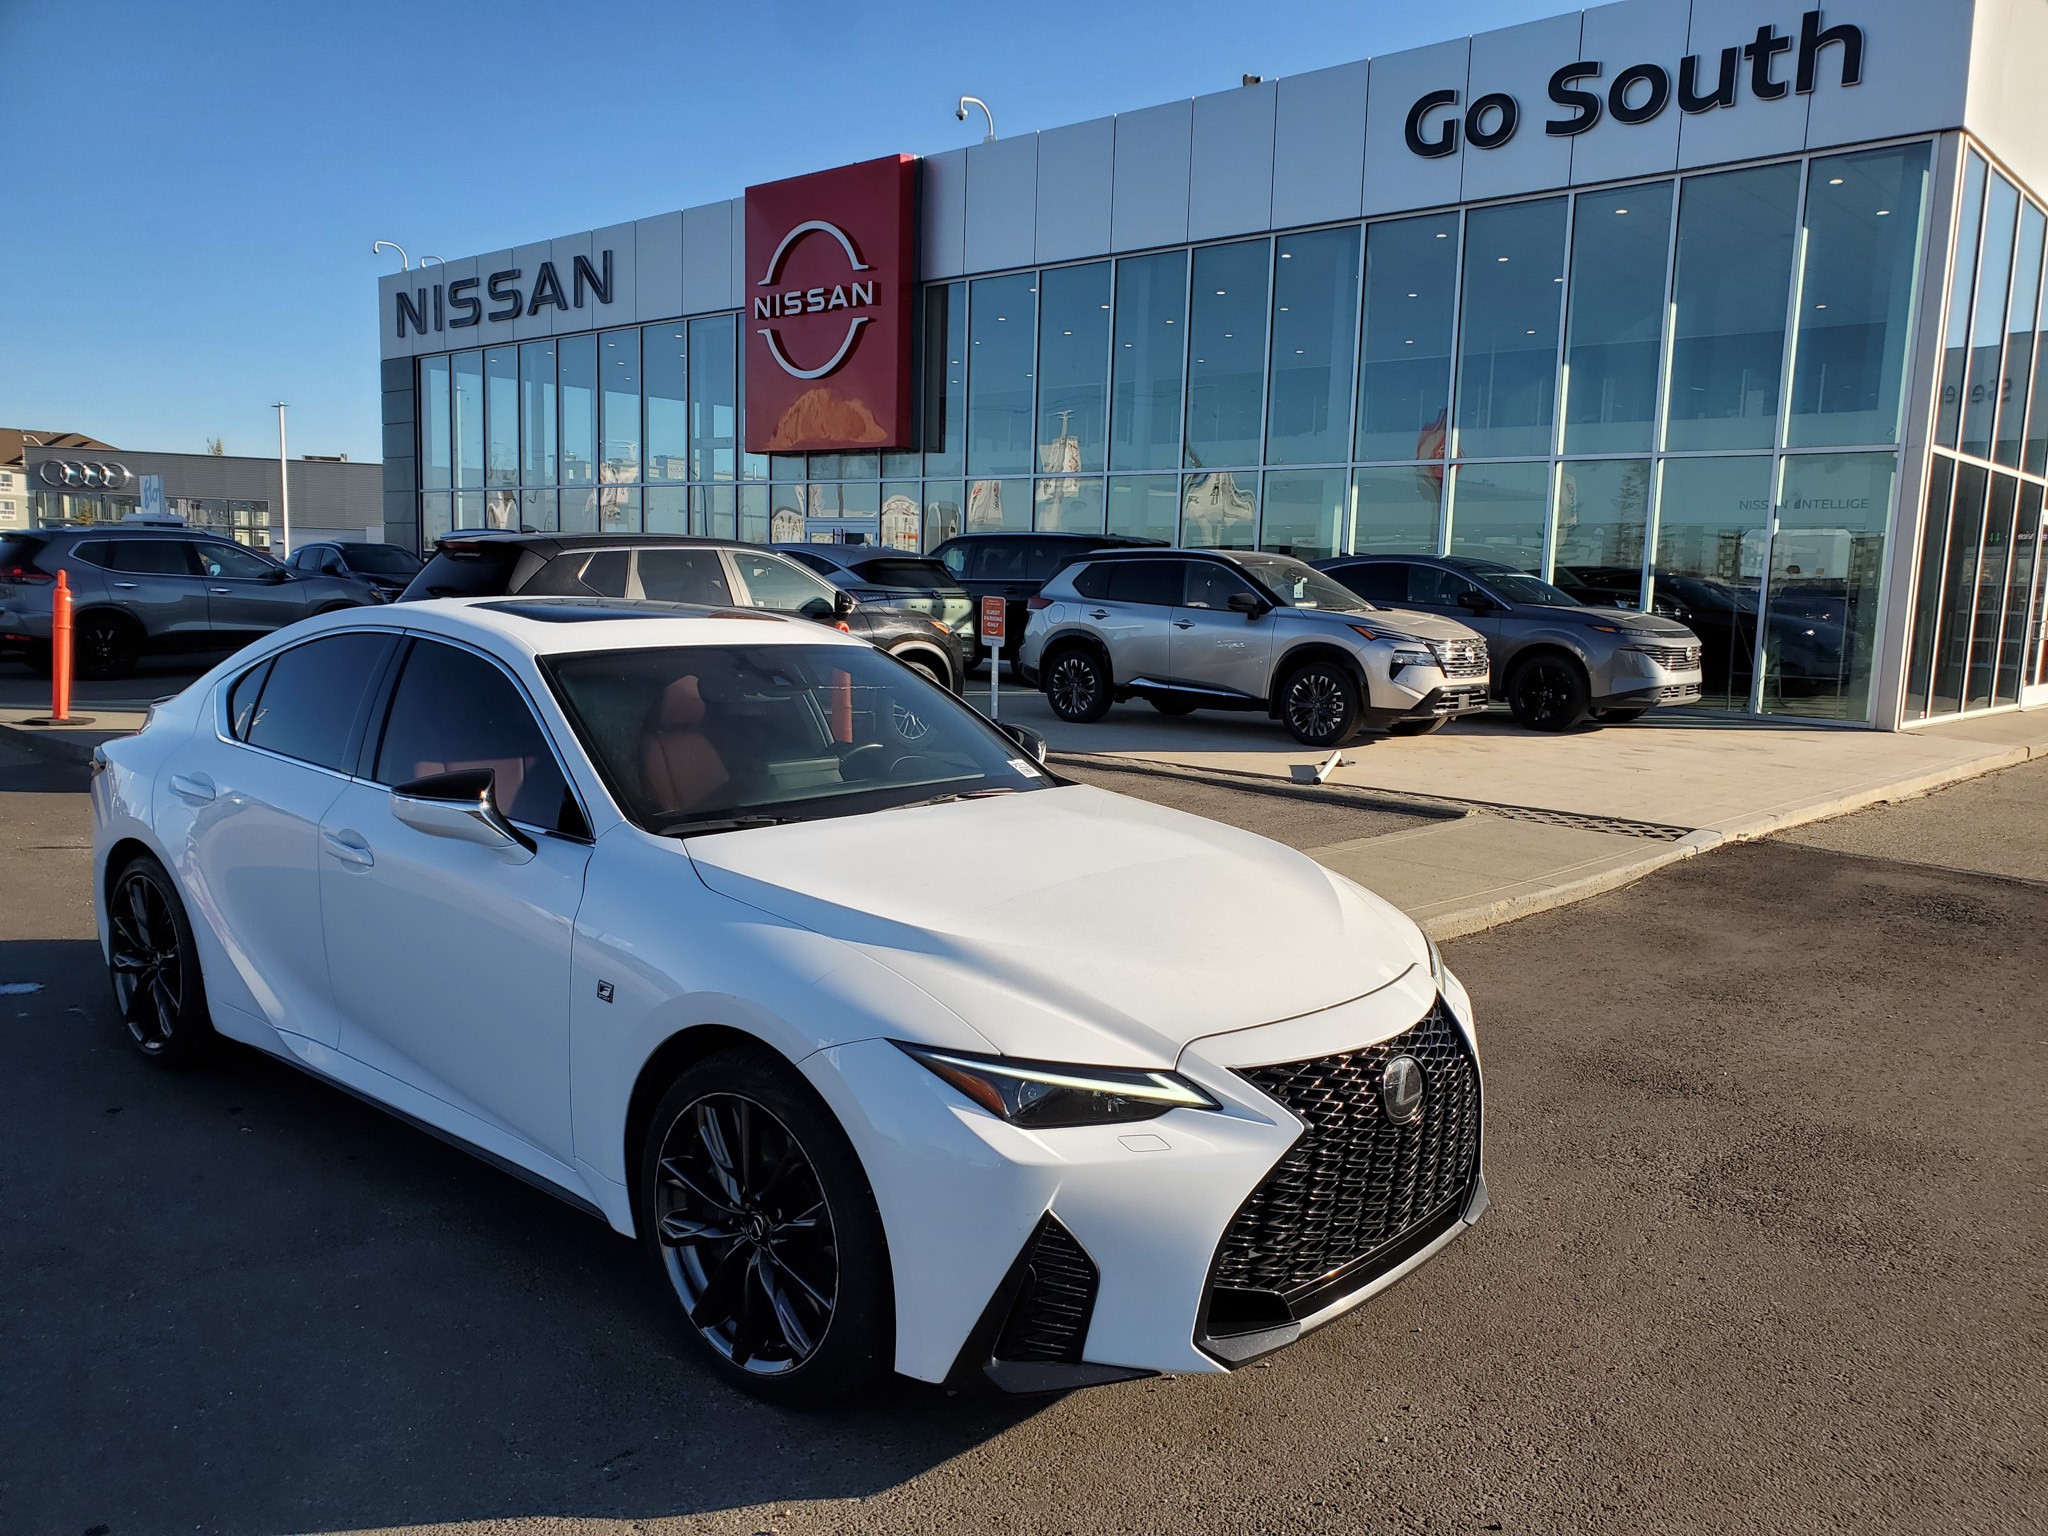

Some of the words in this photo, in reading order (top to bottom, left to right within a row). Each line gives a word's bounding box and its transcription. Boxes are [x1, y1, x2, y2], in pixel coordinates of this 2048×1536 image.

[1404, 89, 1519, 159] Go
[1544, 9, 1866, 138] South
[395, 249, 613, 338] NISSAN
[754, 280, 873, 320] NISSAN
[1739, 499, 1788, 510] NISSN
